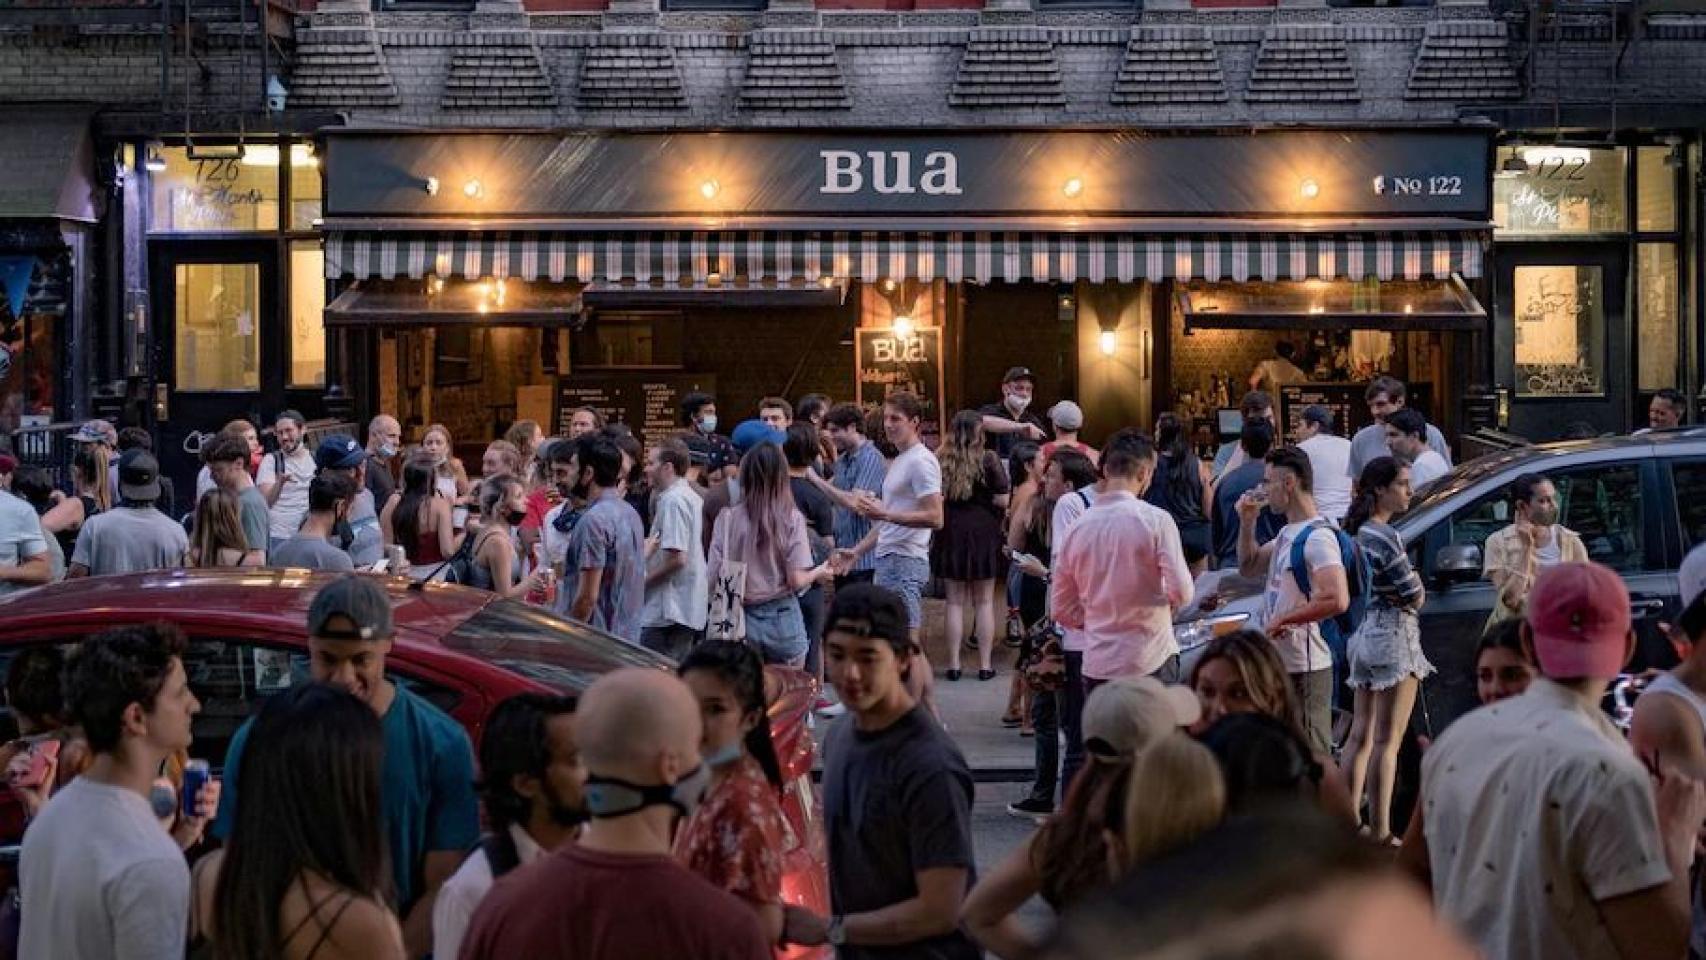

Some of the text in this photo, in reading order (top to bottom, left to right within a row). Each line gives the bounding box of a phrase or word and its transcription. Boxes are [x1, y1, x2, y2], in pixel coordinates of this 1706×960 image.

[819, 150, 963, 194] Bua
[1537, 156, 1585, 180] 122
[1429, 175, 1462, 195] 122
[872, 336, 928, 362] Bua
